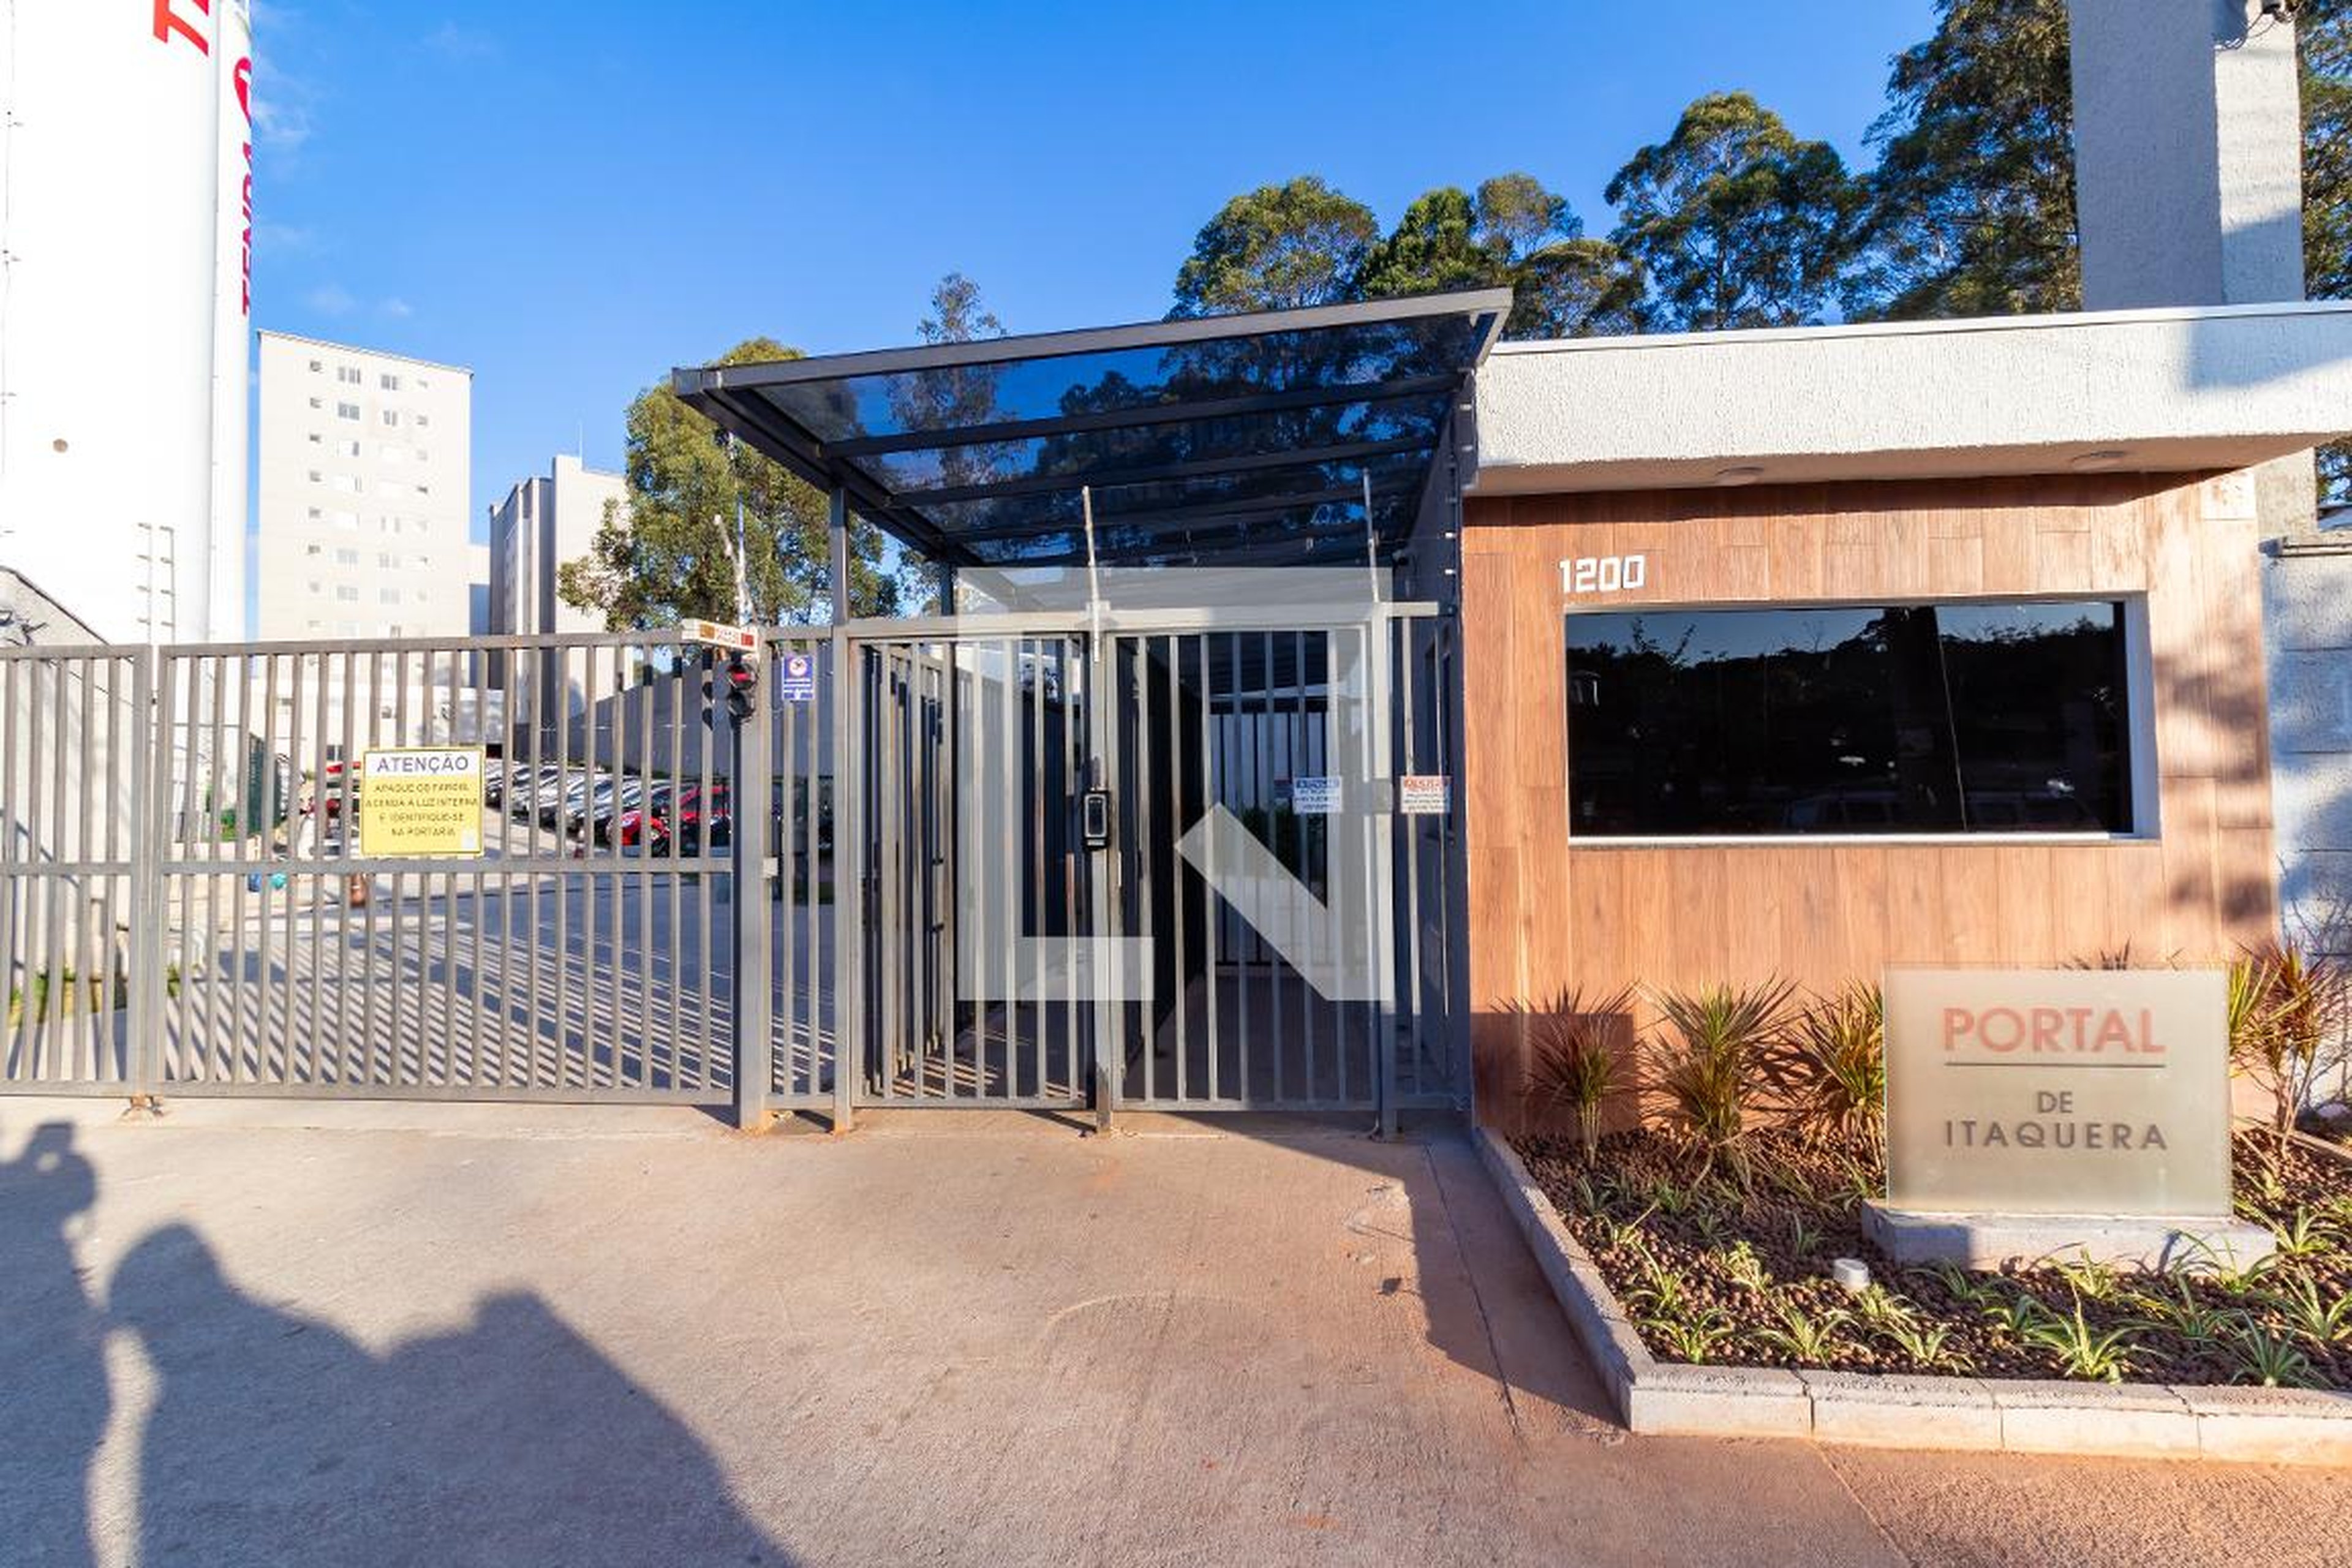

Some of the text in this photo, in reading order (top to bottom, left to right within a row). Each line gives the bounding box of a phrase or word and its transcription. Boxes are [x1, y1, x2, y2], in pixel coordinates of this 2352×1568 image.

[1559, 554, 1645, 593] 1200
[377, 753, 469, 774] ATENÇÃO
[366, 799, 405, 807] ACENDA
[417, 798, 435, 807] LUZ
[437, 798, 478, 807] INTERNA
[390, 812, 464, 821] IDENTIFIQUE-SE
[391, 827, 456, 836] NA PORTARIA
[1943, 1007, 2167, 1054] PORTAL
[2037, 1091, 2073, 1114] DE
[1945, 1120, 2168, 1150] ITAQUERA
